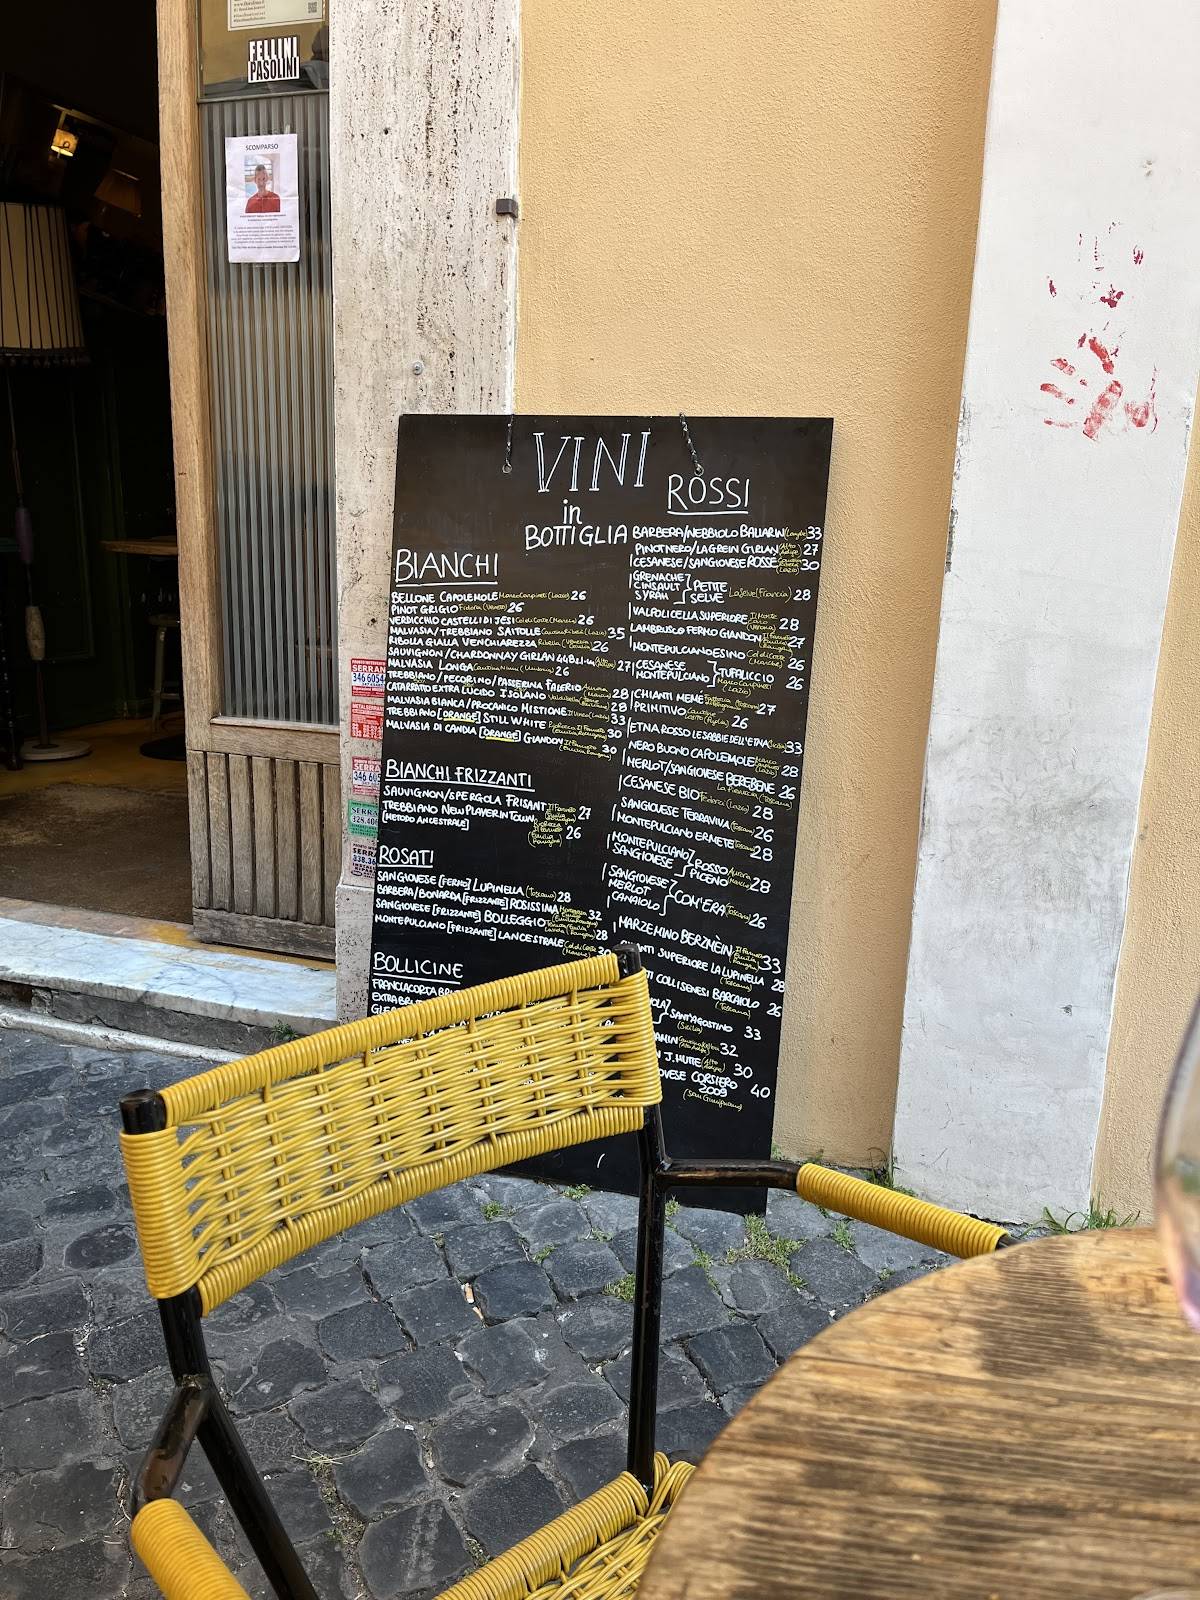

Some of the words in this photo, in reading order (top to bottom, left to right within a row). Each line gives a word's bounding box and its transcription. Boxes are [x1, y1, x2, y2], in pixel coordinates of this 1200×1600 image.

[249, 36, 297, 61] FELLINI
[250, 57, 297, 81] PASOLINI
[245, 143, 279, 151] SCOMPARSO
[533, 432, 651, 493] VINI
[667, 474, 750, 510] ROSSI
[563, 499, 582, 524] in
[525, 524, 628, 550] BOTTIGLIA
[806, 526, 822, 540] 33
[803, 543, 819, 556] 27
[395, 549, 498, 582] BIANCHI
[800, 559, 820, 571] 30
[633, 570, 685, 582] GRENACHE
[633, 581, 680, 591] CINSAULT
[693, 580, 728, 592] PETITE
[391, 592, 435, 603] BELLONE
[570, 590, 587, 601] 26
[635, 590, 669, 601] SYRAH
[690, 593, 724, 604] SELVE
[793, 589, 811, 601] 28
[391, 604, 418, 615] PINOT
[420, 604, 459, 614] GRIGIO
[507, 602, 524, 613] 26
[633, 606, 700, 621] VALPOLICELLA
[779, 618, 800, 631] 28
[389, 616, 440, 626] VERDICCHIO
[494, 616, 515, 625] JESI
[577, 614, 594, 625] 26
[389, 636, 424, 645] RIBOLLA
[425, 638, 459, 647] GIALLA
[591, 641, 609, 652] 26
[607, 627, 625, 640] 35
[630, 623, 685, 635] LAMBRUSCO
[788, 636, 805, 649] 27
[352, 664, 386, 673] SERRAN
[388, 658, 433, 668] MALVASIA
[439, 659, 473, 671] LONGA
[555, 666, 570, 676] 26
[520, 651, 555, 661] GIRLAN
[617, 660, 631, 672] 27
[636, 660, 686, 671] CESANESE
[713, 648, 746, 660] ESINO
[788, 658, 805, 671] 26
[636, 671, 710, 682] MONTEPULCIANO
[786, 676, 804, 690] 26
[432, 685, 460, 693] EXTRA
[461, 686, 496, 697] LUCIDO
[500, 688, 546, 700] ISOLANO
[611, 702, 627, 712] 28
[546, 679, 582, 692] FALERIO
[612, 688, 629, 700] 28
[387, 695, 430, 706] MALVASIA
[611, 713, 626, 725] 33
[634, 688, 672, 701] CHIANTI
[757, 703, 776, 716] 27
[387, 706, 436, 717] TREBBIANO
[483, 712, 509, 725] STILL
[511, 715, 546, 729] WHITE
[607, 728, 622, 739] 30
[634, 701, 686, 716] PRIMITIVO
[731, 715, 749, 729] 26
[386, 719, 430, 731] MALVASIA
[433, 723, 442, 731] DI
[445, 724, 477, 736] CANDIA
[523, 732, 563, 745] GIANDON
[602, 744, 617, 754] 30
[630, 721, 660, 734] ETNA
[660, 724, 691, 737] ROSSO
[784, 741, 803, 754] 33
[628, 740, 655, 752] NERO
[656, 742, 689, 756] BUONO
[781, 765, 799, 777] 28
[386, 759, 450, 781] BIANCHI
[454, 766, 532, 788] FRIZZANTI
[623, 775, 676, 796] CESANESE
[679, 785, 700, 800] BIO
[752, 805, 774, 820] 28
[778, 785, 796, 800] 26
[505, 794, 547, 811] FRISANT
[578, 806, 592, 820] 27
[382, 800, 438, 814] TREBBIANO
[566, 825, 582, 840] 26
[621, 796, 679, 817] SANGIOVESE
[754, 826, 774, 842] 26
[380, 845, 434, 866] ROSATI
[612, 831, 689, 860] MONTEPULCIANO
[612, 842, 674, 869] SANGIOVESE
[750, 845, 773, 861] 28
[608, 865, 669, 888] SANGIOVESE
[694, 859, 728, 875] ROSSO
[377, 871, 437, 885] SANGIOVESE
[472, 877, 525, 896] LUPINELLA
[557, 891, 571, 903] 28
[608, 879, 652, 896] MERLOT
[690, 868, 728, 886] PICENO
[750, 877, 771, 894] 28
[612, 891, 660, 910] CANAIOLO
[376, 898, 431, 912] SANGIOVESE
[596, 929, 608, 940] 28
[588, 909, 602, 921] 32
[749, 913, 768, 929] 26
[375, 914, 446, 930] MONTEPULCIANO
[598, 946, 612, 957] 30
[373, 952, 463, 978] BOLLICINE
[657, 948, 708, 971] SUPERIORE
[711, 962, 721, 975] LA
[722, 966, 764, 986] LUPINELLA
[771, 979, 785, 992] 28
[759, 955, 781, 974] 33
[766, 1003, 782, 1018] 26
[744, 1026, 761, 1041] 33
[720, 1043, 738, 1057] 32
[733, 1063, 753, 1079] 30
[699, 1083, 727, 1097] 2009
[750, 1084, 771, 1098] 40
